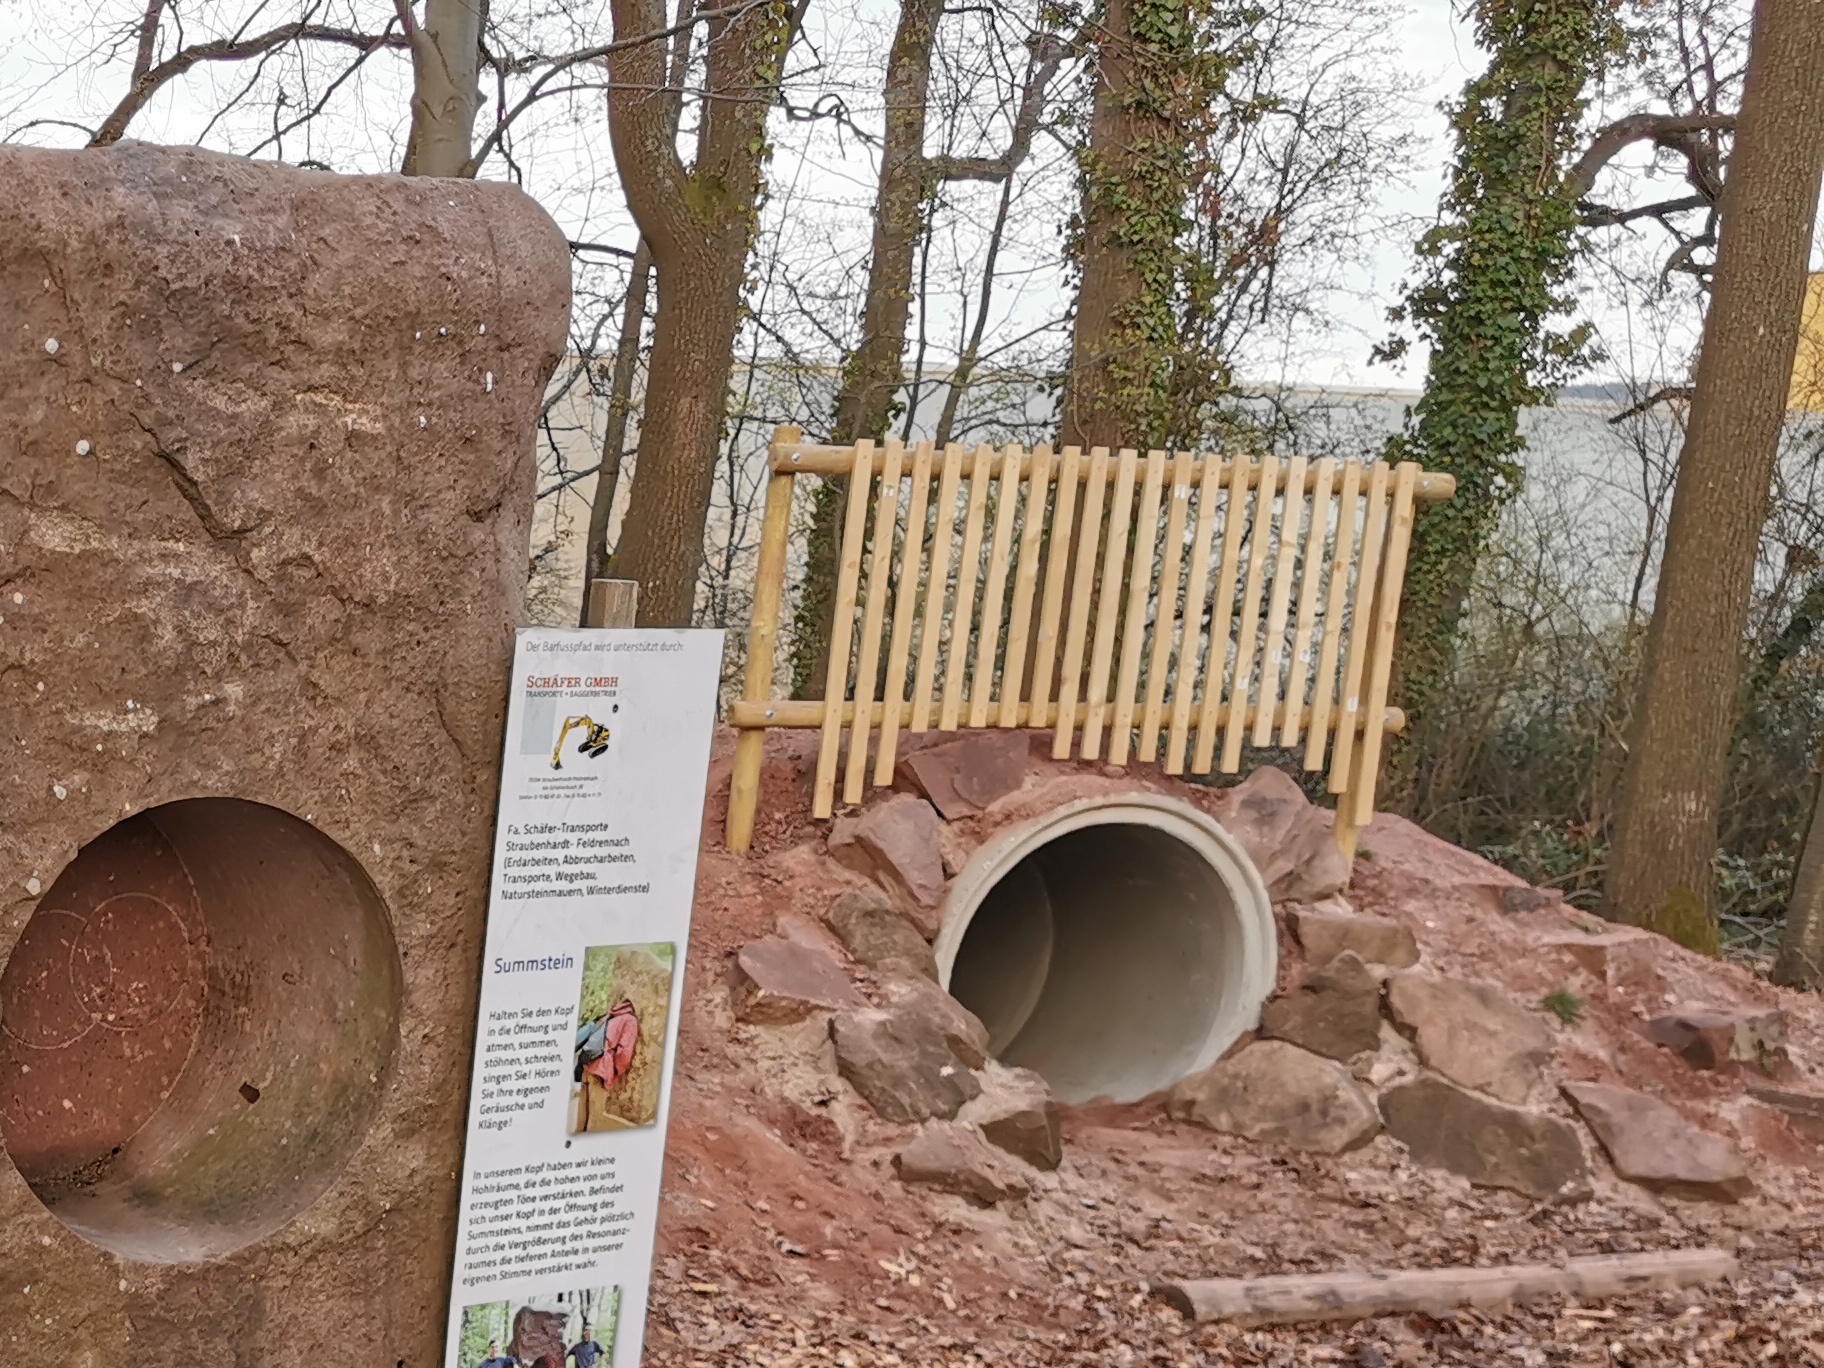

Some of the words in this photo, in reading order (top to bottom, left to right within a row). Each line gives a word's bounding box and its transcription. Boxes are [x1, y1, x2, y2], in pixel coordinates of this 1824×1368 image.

[526, 641, 540, 651] Der
[543, 641, 592, 654] Barfusspfad
[594, 641, 611, 651] wird
[613, 642, 658, 651] unterstützt
[526, 690, 563, 698] TRANSPORTE
[508, 825, 521, 835] Fa.
[506, 838, 574, 852] Straubenhardt-
[577, 837, 629, 848] Feldrennach
[504, 856, 560, 869] (Erdarbeiten,
[563, 854, 636, 866] Abbrucharbeiten,
[503, 872, 552, 885] Transporte,
[555, 870, 597, 883] Wegebau,
[501, 887, 584, 900] Natursteinmauern,
[586, 882, 649, 896] Winterdienste)
[495, 954, 573, 973] Summstein
[489, 1010, 518, 1021] Halten
[521, 1008, 533, 1019] Sie
[536, 1006, 552, 1018] den
[554, 1005, 575, 1018] Kopf
[488, 1027, 496, 1036] in
[498, 1025, 512, 1036] die
[513, 1022, 549, 1036] Öffnung
[552, 1020, 568, 1032] und
[486, 1041, 516, 1053] atmen,
[519, 1038, 558, 1050] summen,
[485, 1056, 522, 1068] stöhnen,
[525, 1053, 563, 1064] schreien,
[483, 1072, 512, 1085] singen
[515, 1069, 531, 1081] Sie!
[534, 1068, 560, 1079] Hören
[482, 1088, 495, 1100] Sie
[497, 1087, 513, 1097] Ihre
[516, 1084, 550, 1097] eigenen
[480, 1102, 525, 1115] Geräusche
[528, 1099, 544, 1109] und
[479, 1117, 512, 1130] Klänge!
[473, 1170, 481, 1180] In
[484, 1166, 522, 1179] unserem
[525, 1162, 545, 1175] Kopf
[547, 1161, 573, 1172] haben
[575, 1159, 588, 1168] wir
[591, 1156, 615, 1166] kleine
[472, 1181, 521, 1195] Hohlräume,
[524, 1179, 536, 1189] die
[539, 1177, 551, 1187] die
[554, 1175, 580, 1185] hohen
[583, 1173, 598, 1182] von
[600, 1171, 615, 1180] uns
[470, 1198, 514, 1212] erzeugten
[516, 1193, 537, 1205] Töne
[539, 1189, 586, 1202] verstärken.
[589, 1184, 624, 1196] Befindet
[469, 1215, 486, 1226] sich
[488, 1212, 513, 1223] unser
[515, 1208, 535, 1221] Kopf
[537, 1206, 545, 1216] in
[548, 1204, 561, 1214] der
[564, 1200, 598, 1213] Öffnung
[600, 1199, 615, 1209] des
[467, 1226, 523, 1241] Summsteins,
[526, 1222, 553, 1232] nimmt
[556, 1219, 571, 1229] das
[573, 1214, 597, 1226] Gehör
[600, 1211, 634, 1225] plötzlich
[465, 1244, 490, 1256] durch
[492, 1242, 505, 1252] die
[508, 1234, 566, 1251] Vergrößerung
[569, 1232, 584, 1242] des
[586, 1228, 630, 1239] Resonanz-
[464, 1259, 497, 1271] raumes
[500, 1256, 512, 1266] die
[515, 1250, 548, 1263] tieferen
[550, 1248, 579, 1259] Anteile
[581, 1245, 589, 1255] in
[592, 1242, 624, 1253] unserer
[463, 1274, 497, 1286] eigenen
[499, 1269, 532, 1281] Stimme
[534, 1263, 573, 1276] verstärkt
[575, 1260, 598, 1271] wahr.
